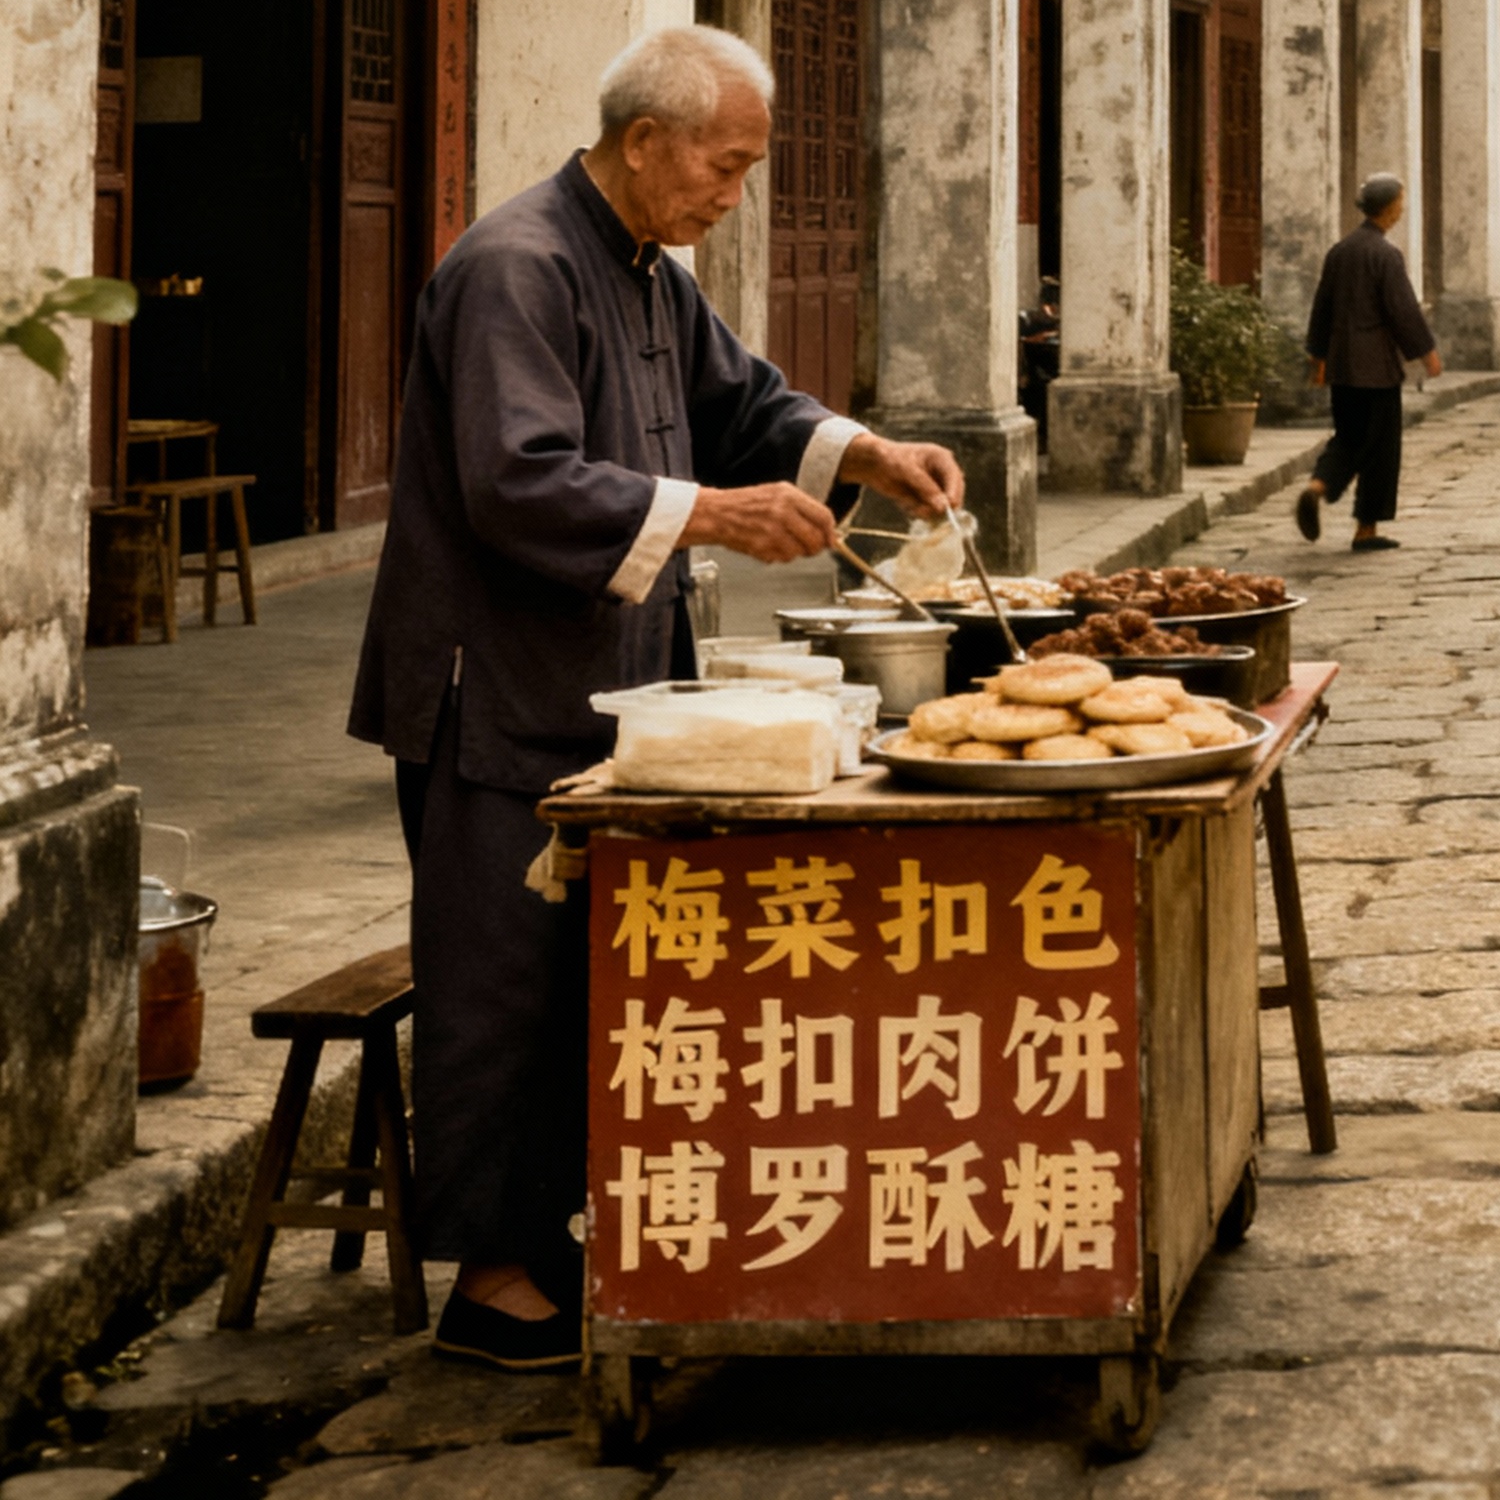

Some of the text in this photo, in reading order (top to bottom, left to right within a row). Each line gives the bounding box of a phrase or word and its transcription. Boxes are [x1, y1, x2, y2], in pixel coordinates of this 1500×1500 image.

[612, 854, 1120, 980] 梅菜扣色
[608, 991, 1124, 1122] 梅扣肉饼
[605, 1139, 1124, 1272] 博罗酥糖
